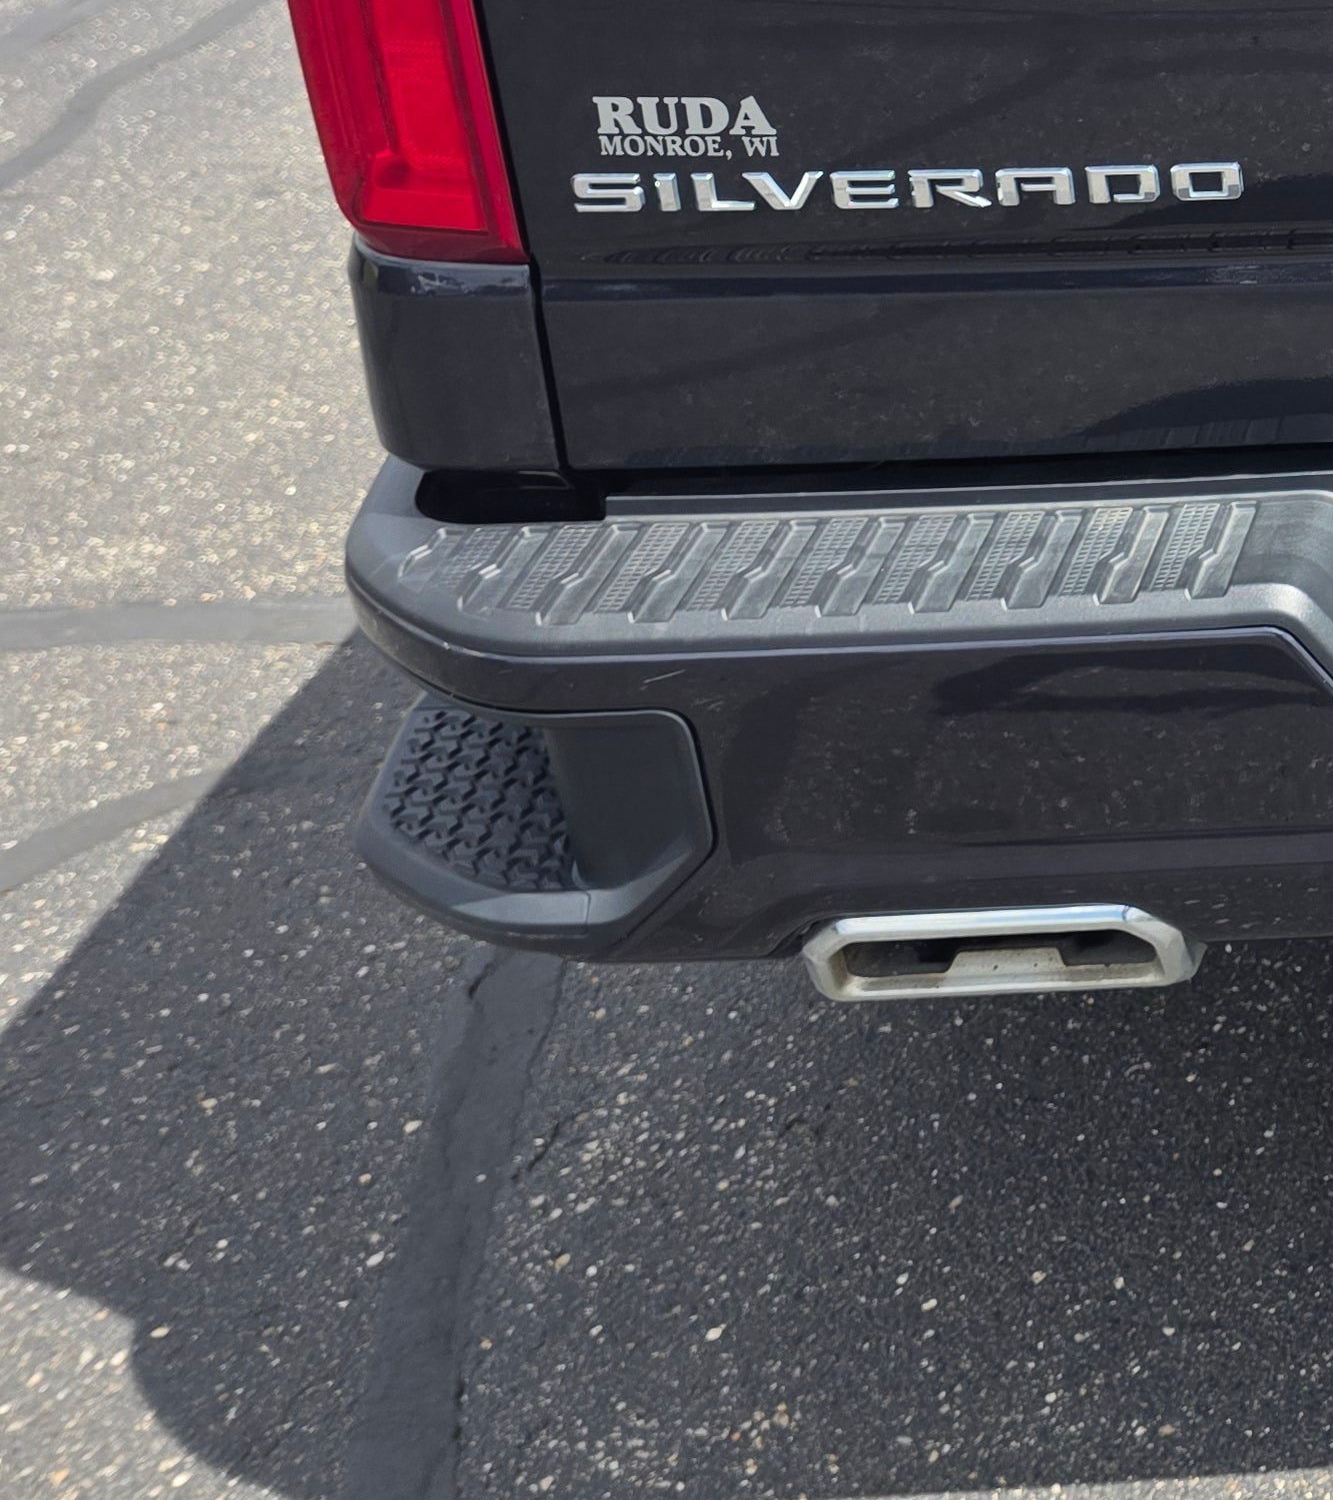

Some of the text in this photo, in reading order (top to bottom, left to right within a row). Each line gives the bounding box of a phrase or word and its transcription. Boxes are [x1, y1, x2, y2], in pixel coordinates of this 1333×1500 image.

[591, 95, 778, 136] RUDA
[598, 135, 780, 161] MONROE, WI
[571, 160, 1244, 213] SILVERADO
